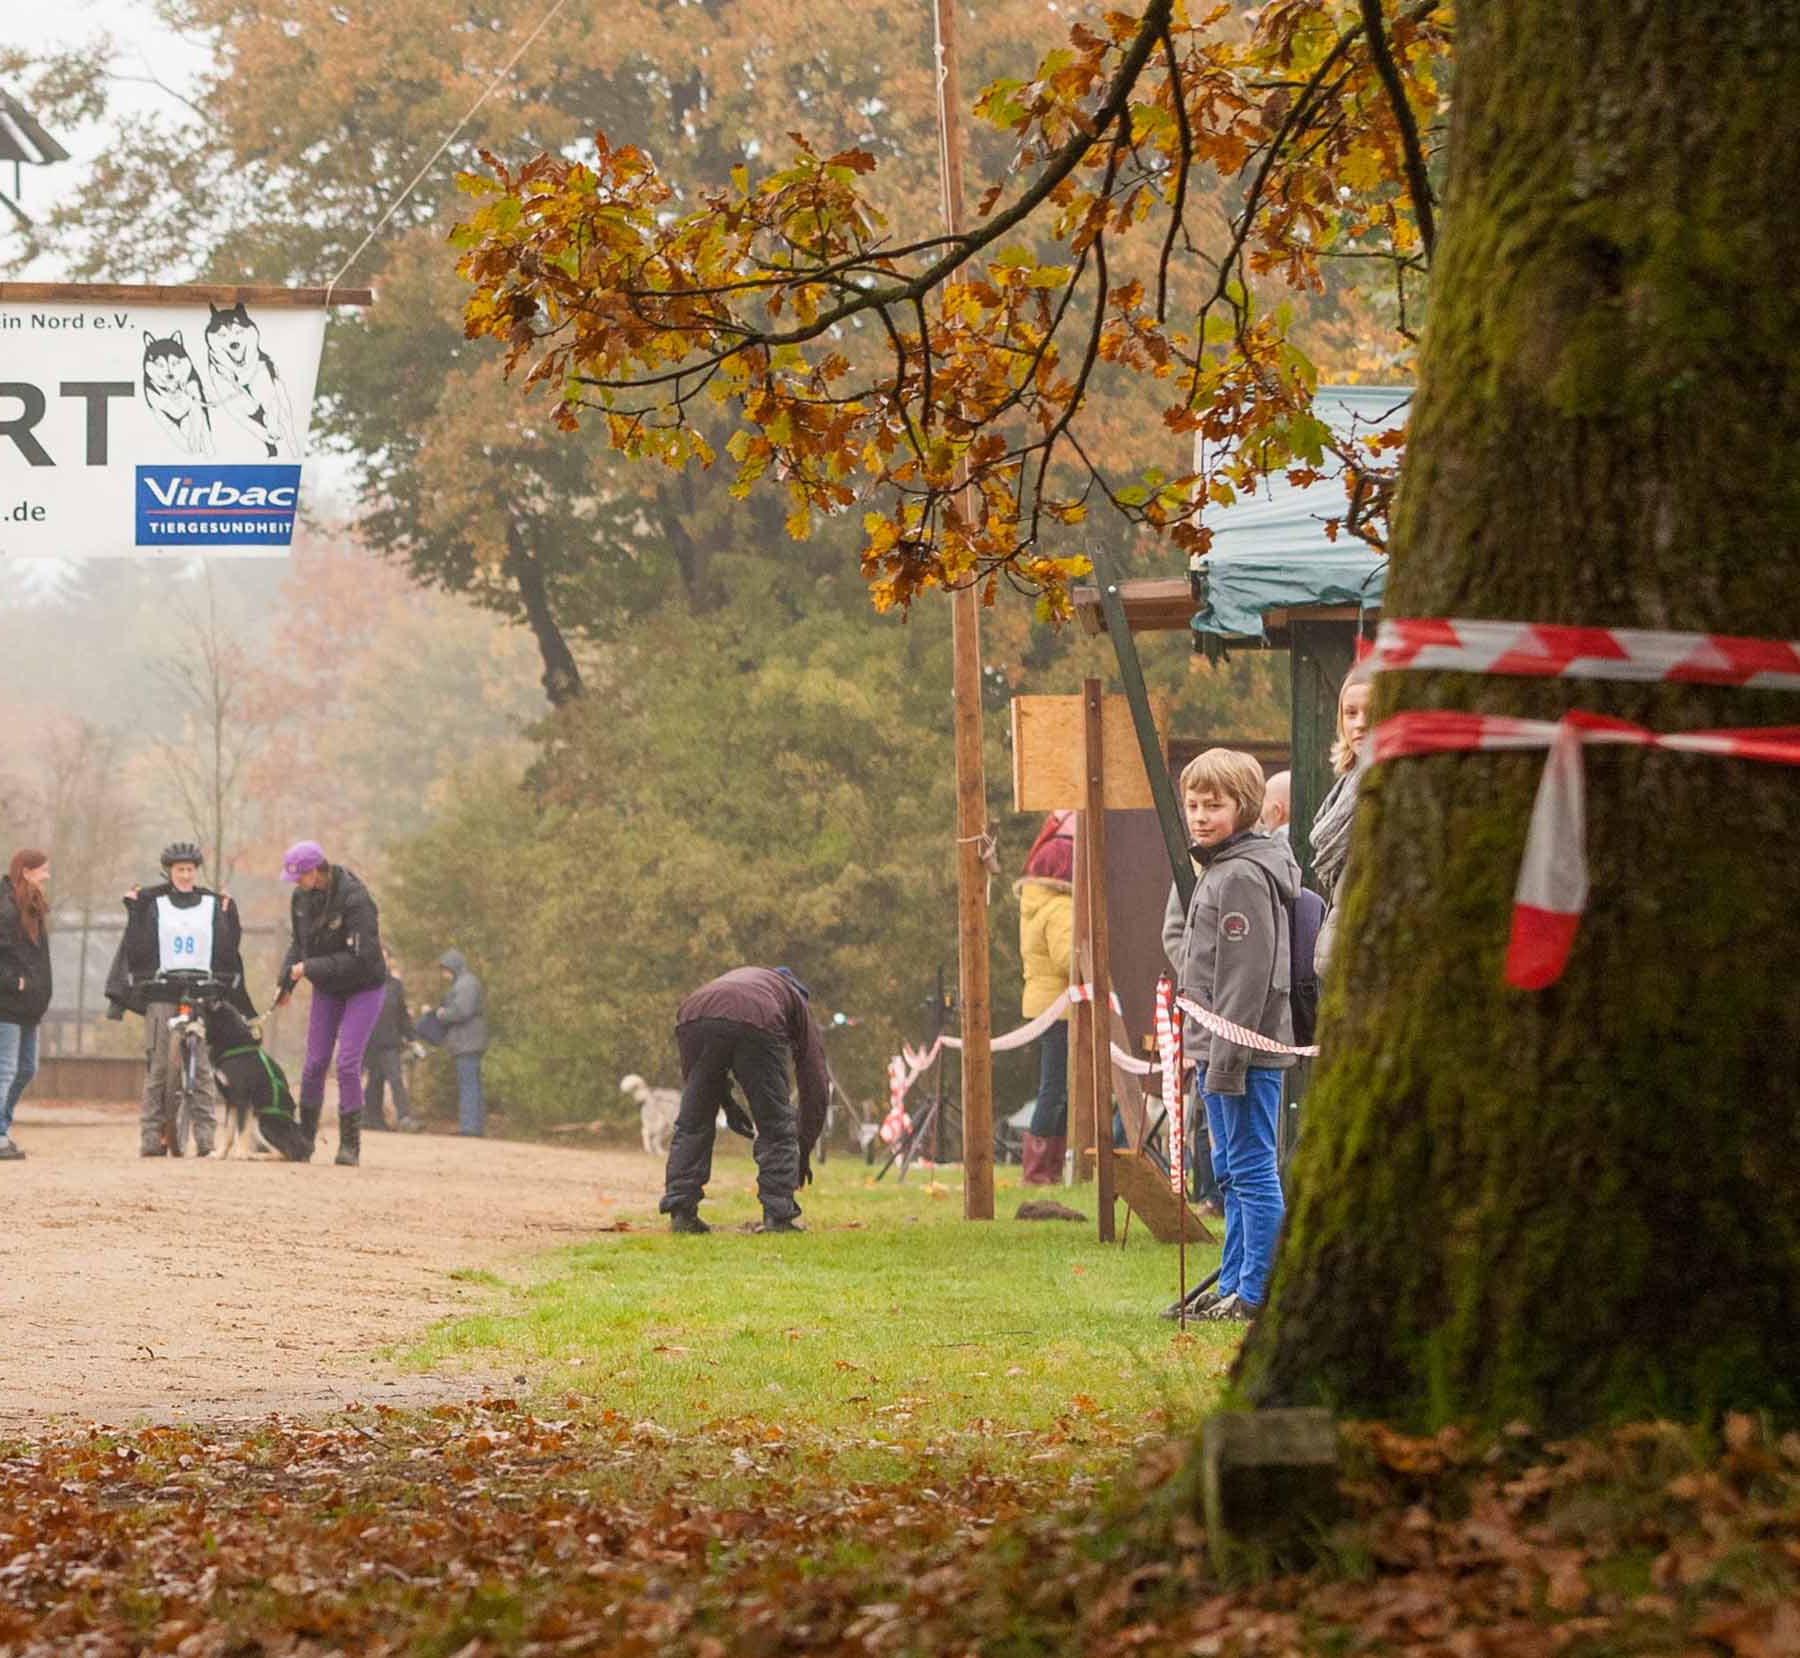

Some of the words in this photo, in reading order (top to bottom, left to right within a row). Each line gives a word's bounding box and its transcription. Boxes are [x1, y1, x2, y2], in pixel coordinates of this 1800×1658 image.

[31, 313, 84, 329] Nord
[93, 313, 136, 329] e.V.
[143, 477, 295, 507] Virbac
[149, 522, 292, 534] TIERGESUNDHEIT
[173, 936, 196, 954] 98
